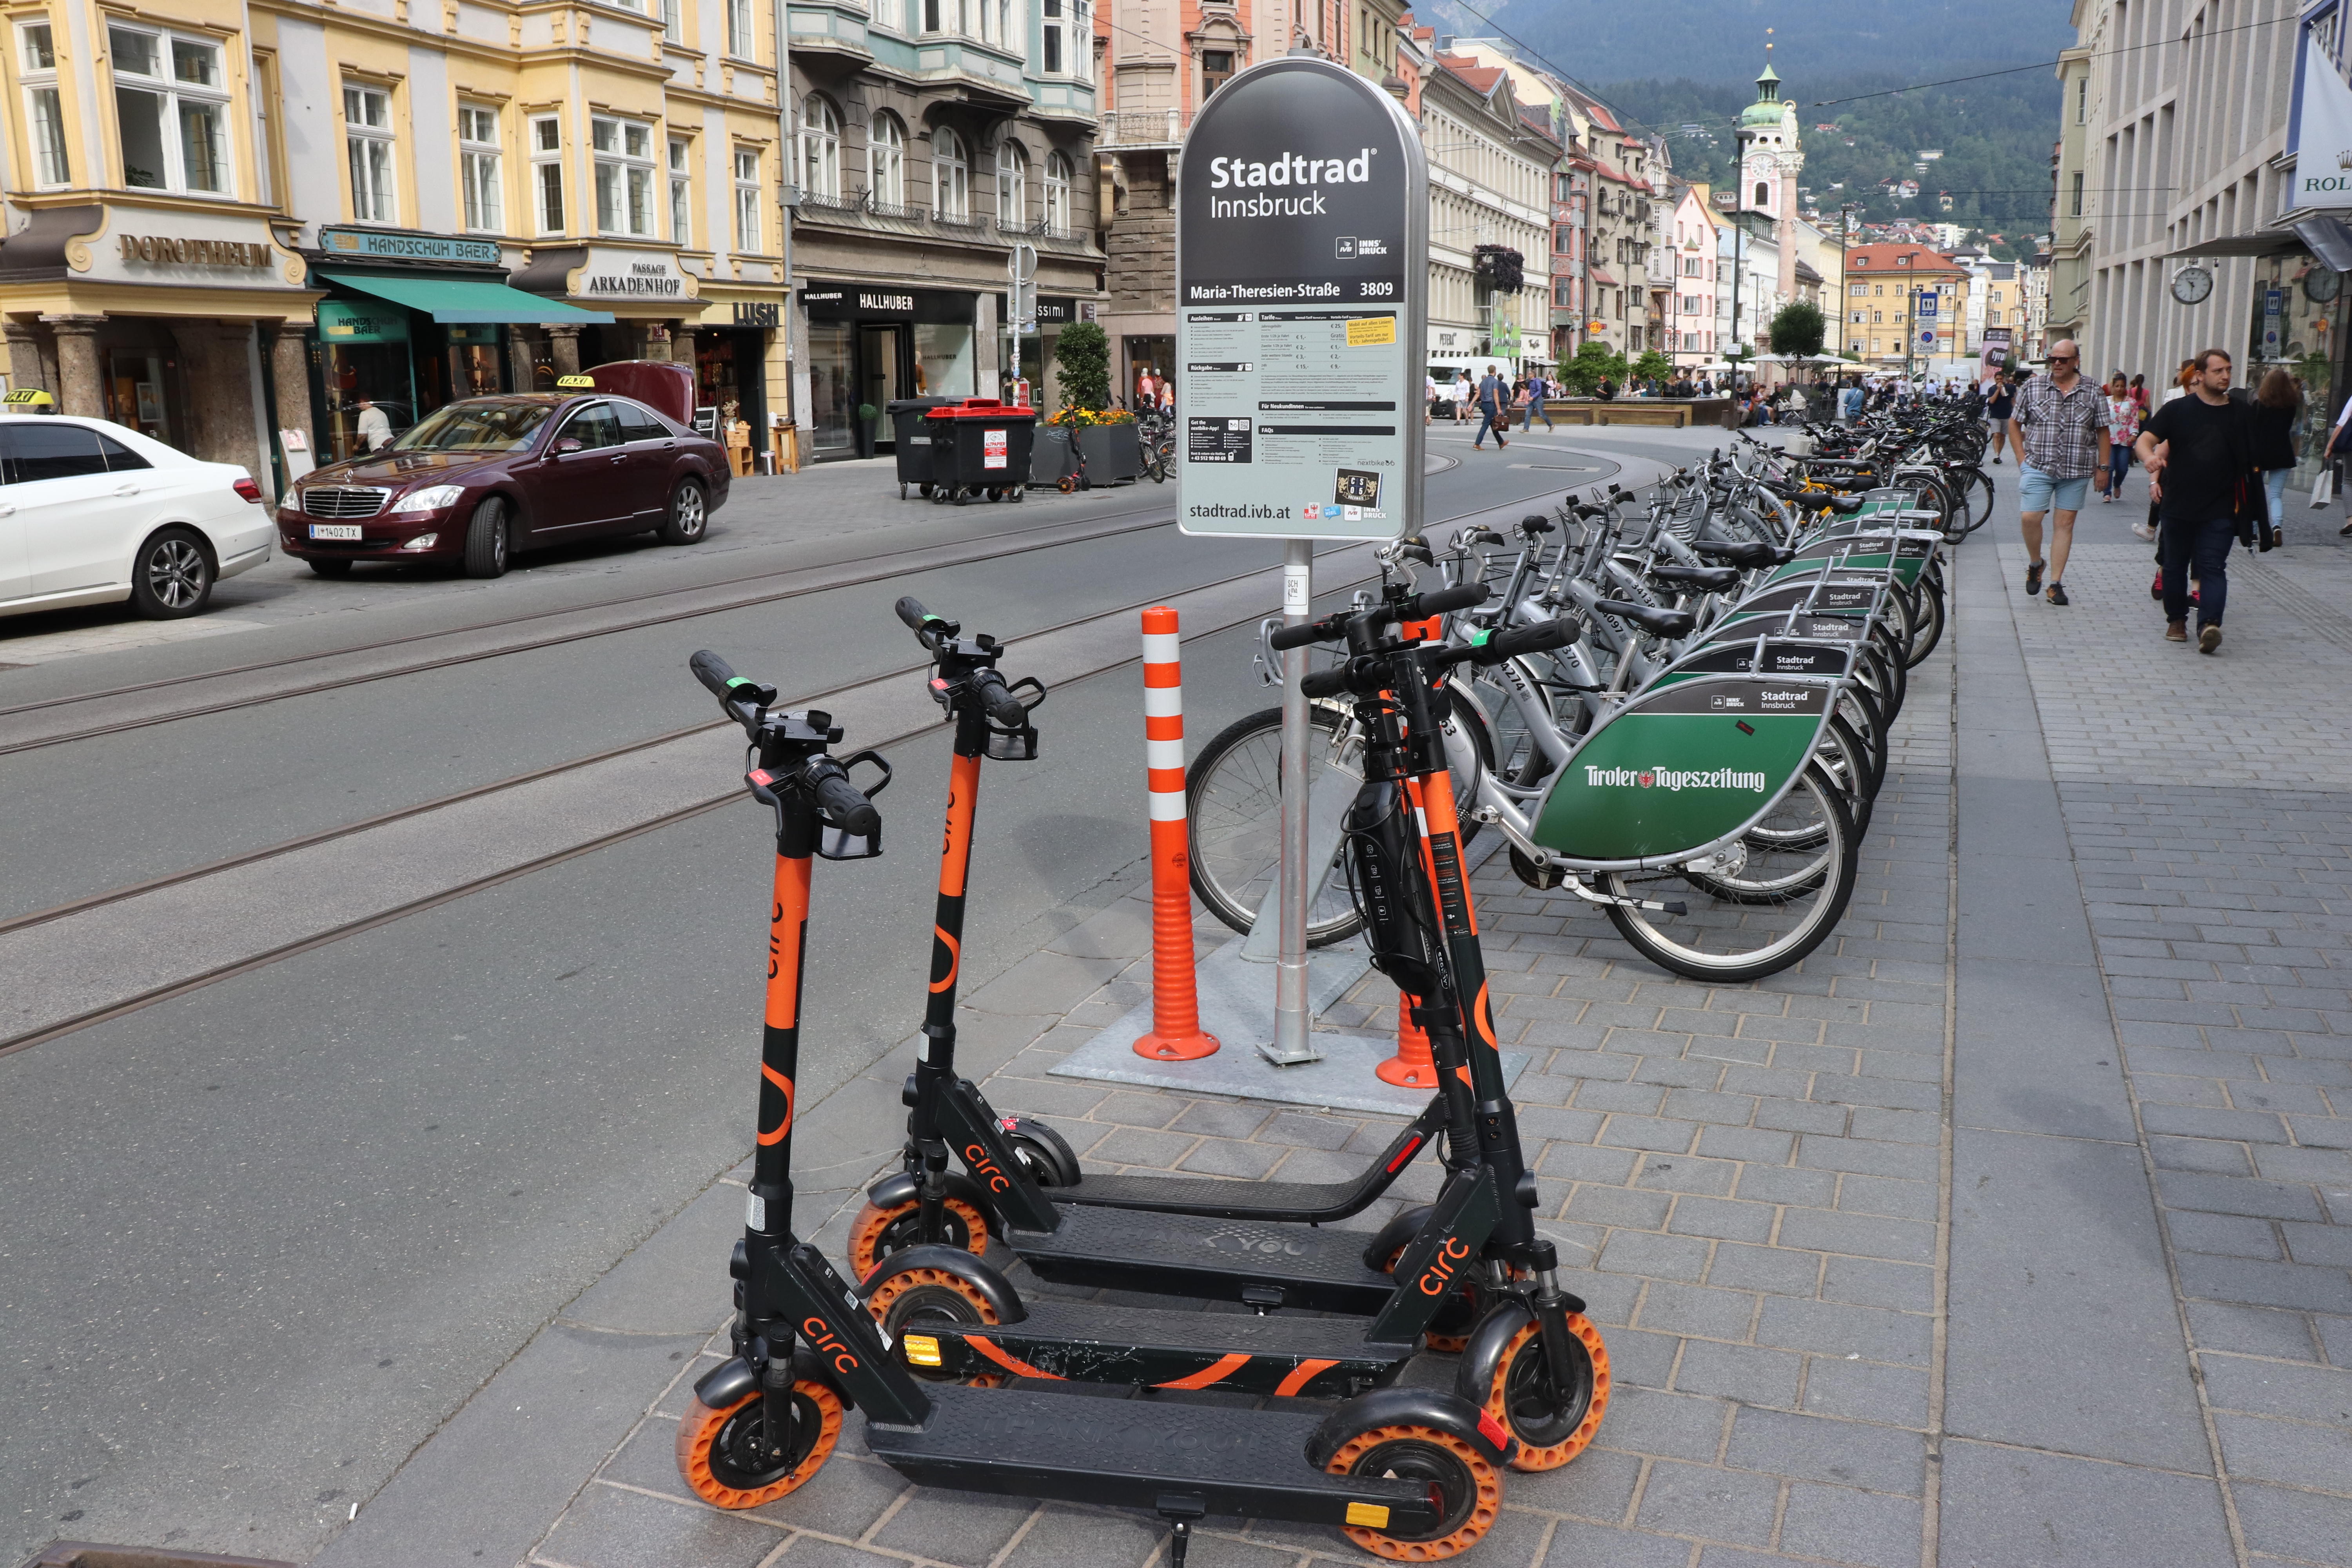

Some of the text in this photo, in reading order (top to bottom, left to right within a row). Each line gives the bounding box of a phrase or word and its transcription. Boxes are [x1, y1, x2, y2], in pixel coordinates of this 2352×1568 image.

[1211, 191, 1327, 218] Innsbruck
[116, 234, 274, 268] DOROTHEUM
[368, 237, 490, 259] HANDSCHUH BAER
[1359, 247, 1387, 255] BRUCK
[632, 263, 666, 274] PASSAGE
[589, 276, 680, 294] ARKADENHOF
[1191, 282, 1393, 299] Maria-Theresien-Straße 3809
[860, 294, 913, 310] HALLHUBER
[733, 302, 779, 326] LUSH
[353, 325, 381, 335] BAER
[6, 392, 33, 401] TAXI
[1190, 503, 1290, 520] stadtrad.ivb.at
[1772, 501, 1785, 517] 34406
[325, 527, 357, 537] 1402 TX
[1755, 523, 1772, 543] 34197
[1632, 582, 1655, 608] 34138
[1602, 612, 1624, 633] 4097
[1561, 646, 1580, 669] 370
[1500, 661, 1524, 691] 4274
[1761, 691, 1809, 701] Stadtrad
[1584, 766, 1765, 793] Tiroler Tageszeitung
[965, 1144, 1010, 1193] circ
[1419, 1237, 1469, 1296] circ
[803, 1317, 858, 1374] circ
